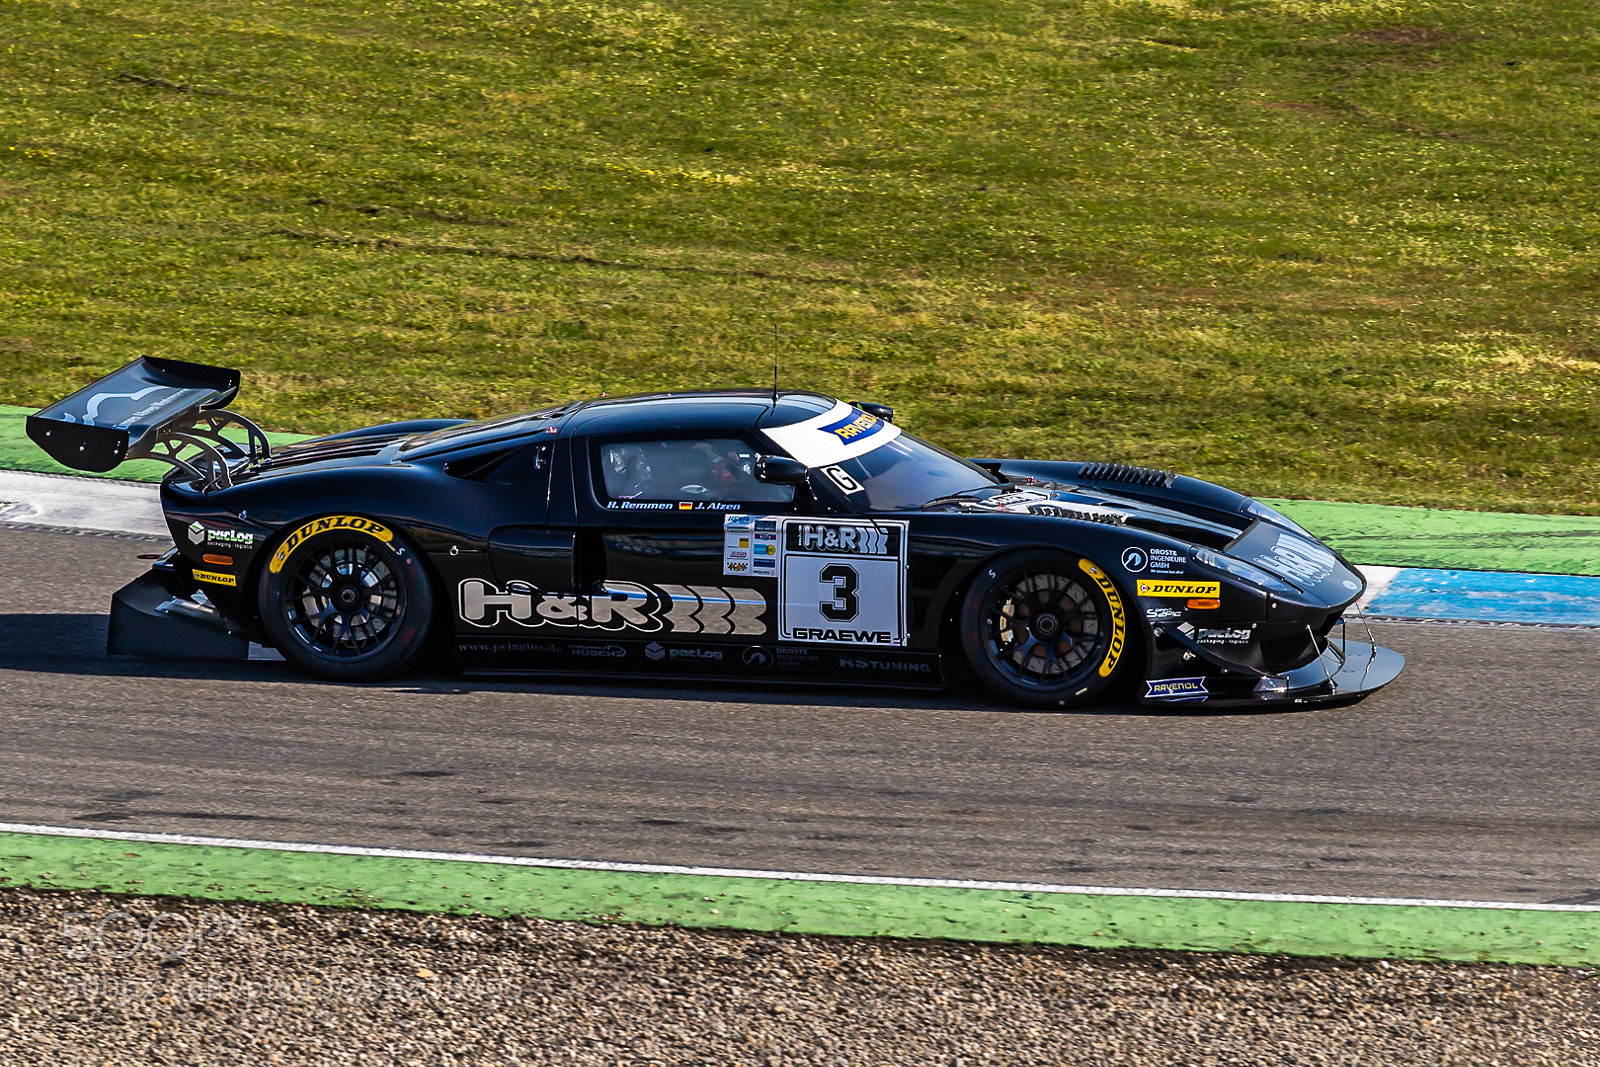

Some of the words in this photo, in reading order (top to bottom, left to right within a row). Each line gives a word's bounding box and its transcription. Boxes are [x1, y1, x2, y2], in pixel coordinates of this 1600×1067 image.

[826, 467, 857, 491] G
[606, 501, 619, 509] H.
[620, 501, 674, 510] Remmen
[695, 502, 705, 510] J.
[706, 502, 741, 511] Alzen
[286, 516, 385, 553] DUNLOP
[803, 524, 860, 553] H&R
[1149, 548, 1178, 556] DROSTE
[1149, 555, 1187, 563] INGENIEURE
[200, 573, 235, 583] DUNLOP
[819, 562, 860, 623] 3
[1152, 585, 1217, 594] DUNLOP
[458, 578, 663, 633] H&R
[1095, 576, 1125, 670] DUNLOP
[792, 628, 892, 643] GRAEWE
[1153, 682, 1198, 692] RAVENOL
